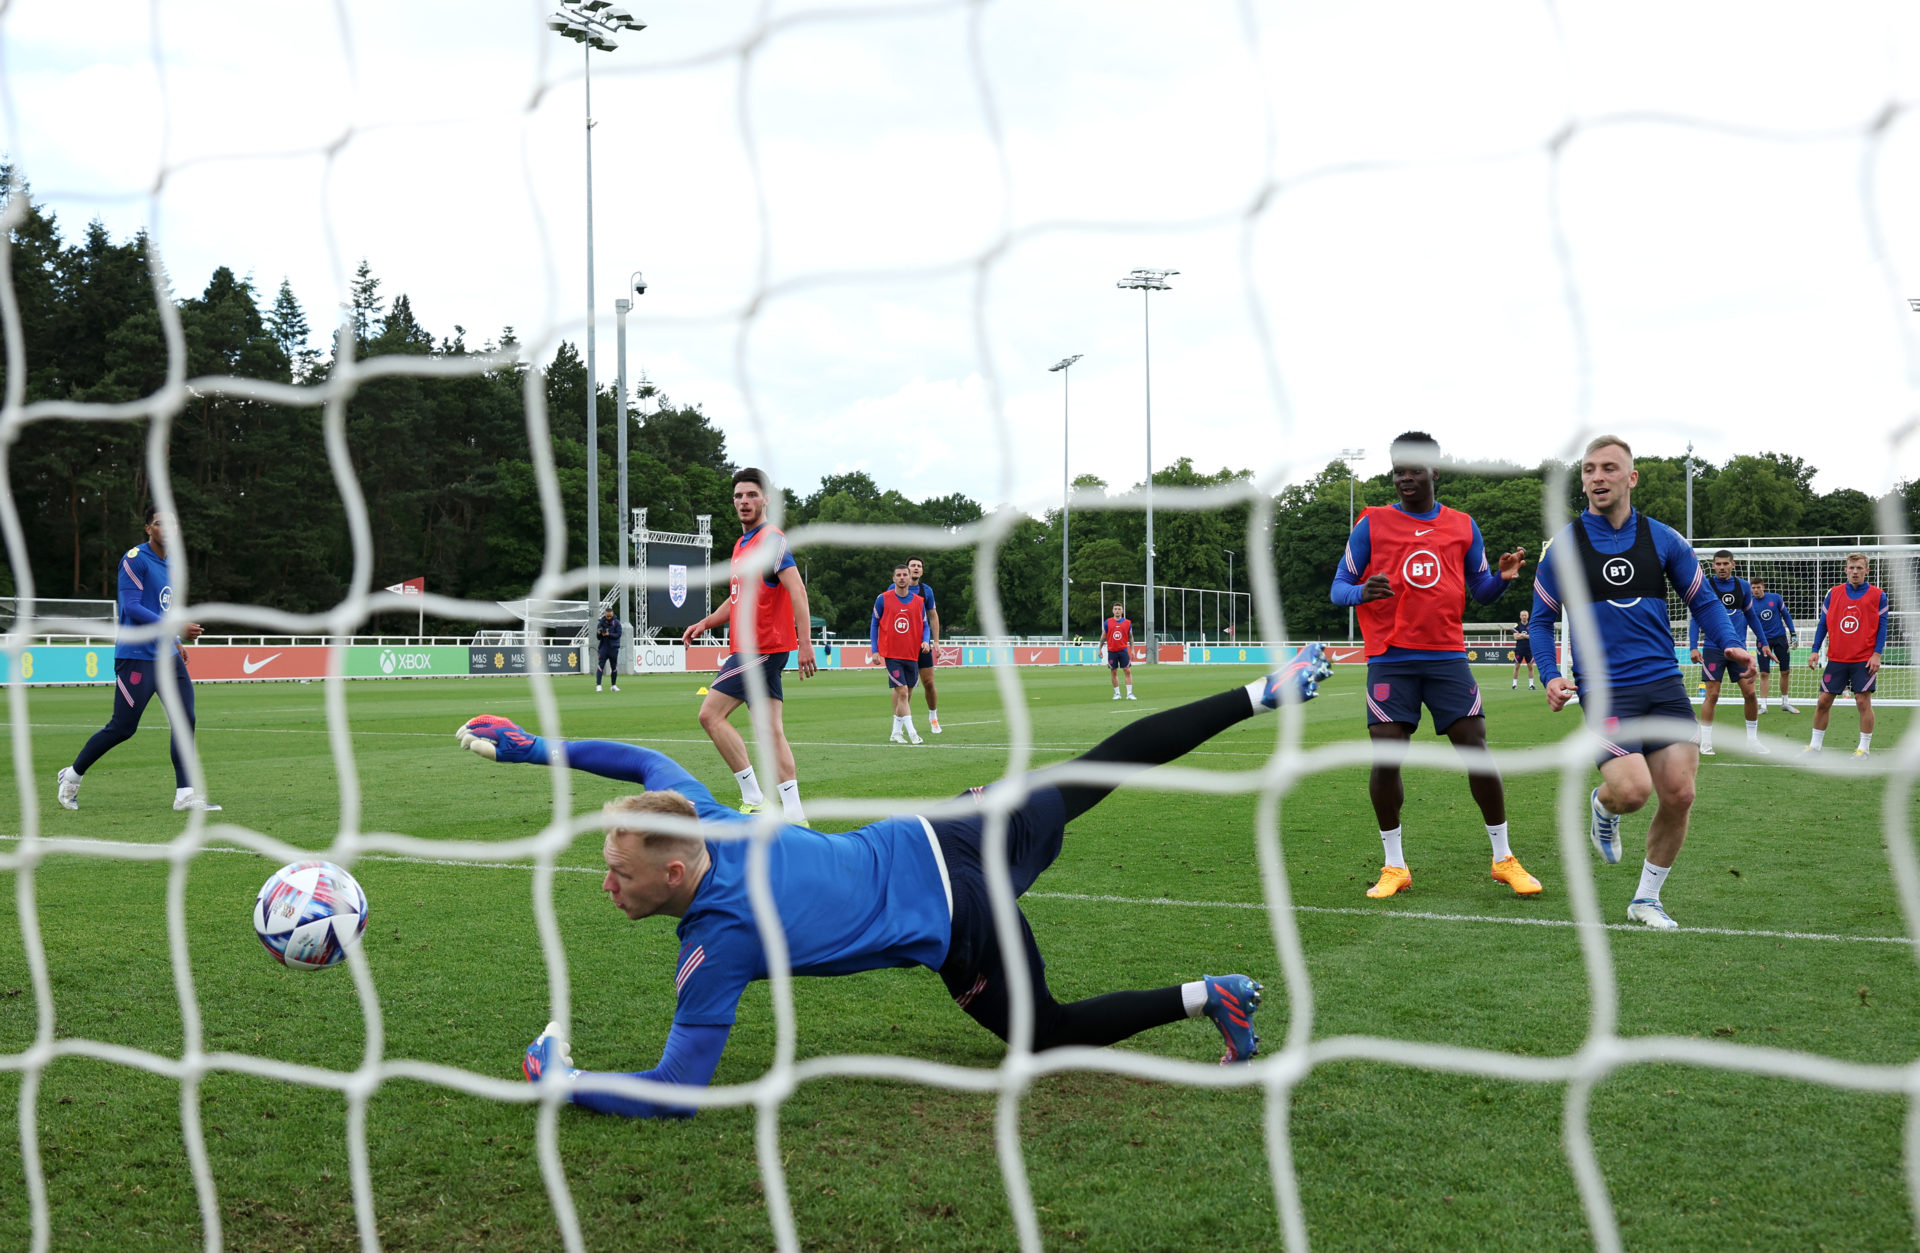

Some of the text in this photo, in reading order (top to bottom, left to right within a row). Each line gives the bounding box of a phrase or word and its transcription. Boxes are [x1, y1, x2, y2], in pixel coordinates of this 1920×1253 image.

[1412, 562, 1434, 576] BT
[1610, 565, 1627, 577] BT
[1844, 620, 1855, 628] BT
[398, 653, 432, 669] XBOX
[472, 654, 487, 664] M&S
[511, 654, 525, 664] M&S
[548, 653, 562, 663] M&S
[646, 649, 675, 666] Cloud
